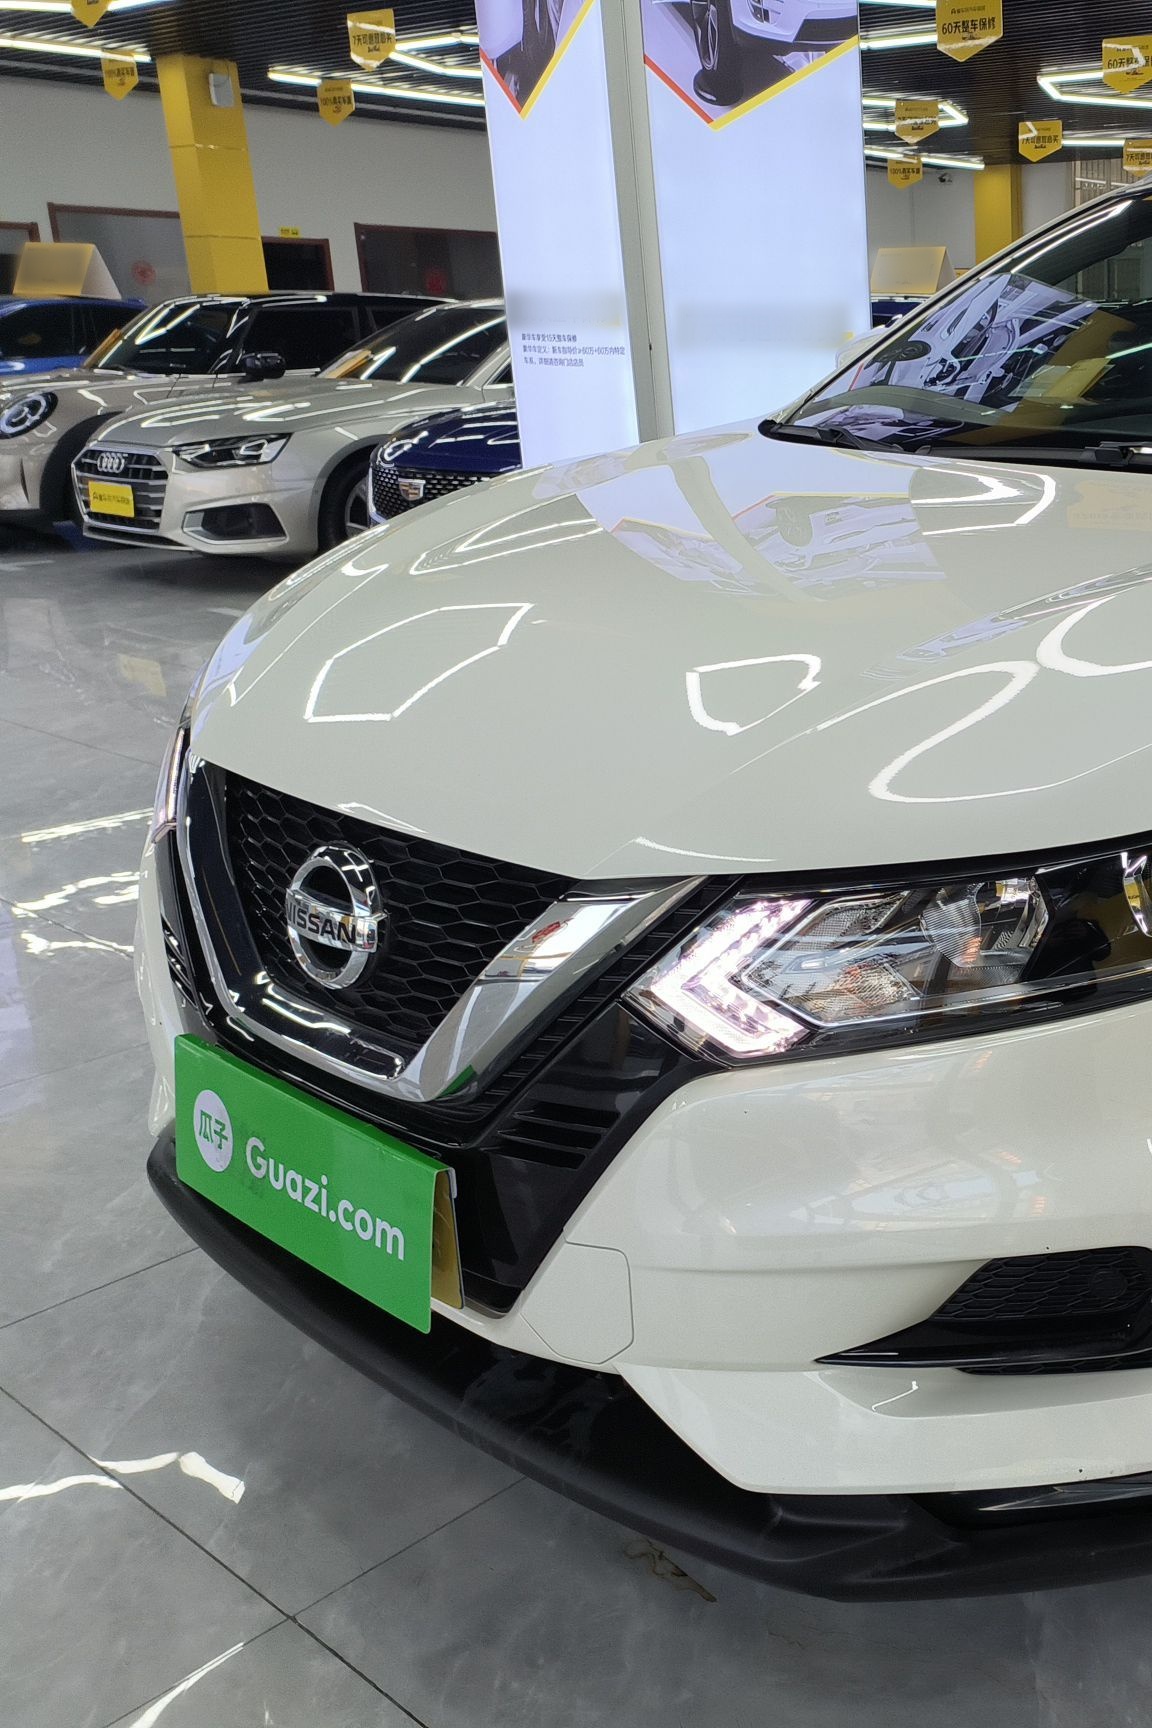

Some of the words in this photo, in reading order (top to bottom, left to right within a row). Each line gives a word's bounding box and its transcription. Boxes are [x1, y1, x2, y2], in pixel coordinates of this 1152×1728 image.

[941, 16, 996, 35] 60天整车保修
[286, 899, 357, 945] NISSAN
[199, 1109, 229, 1151] 瓜子
[245, 1136, 405, 1261] Guazi.com
